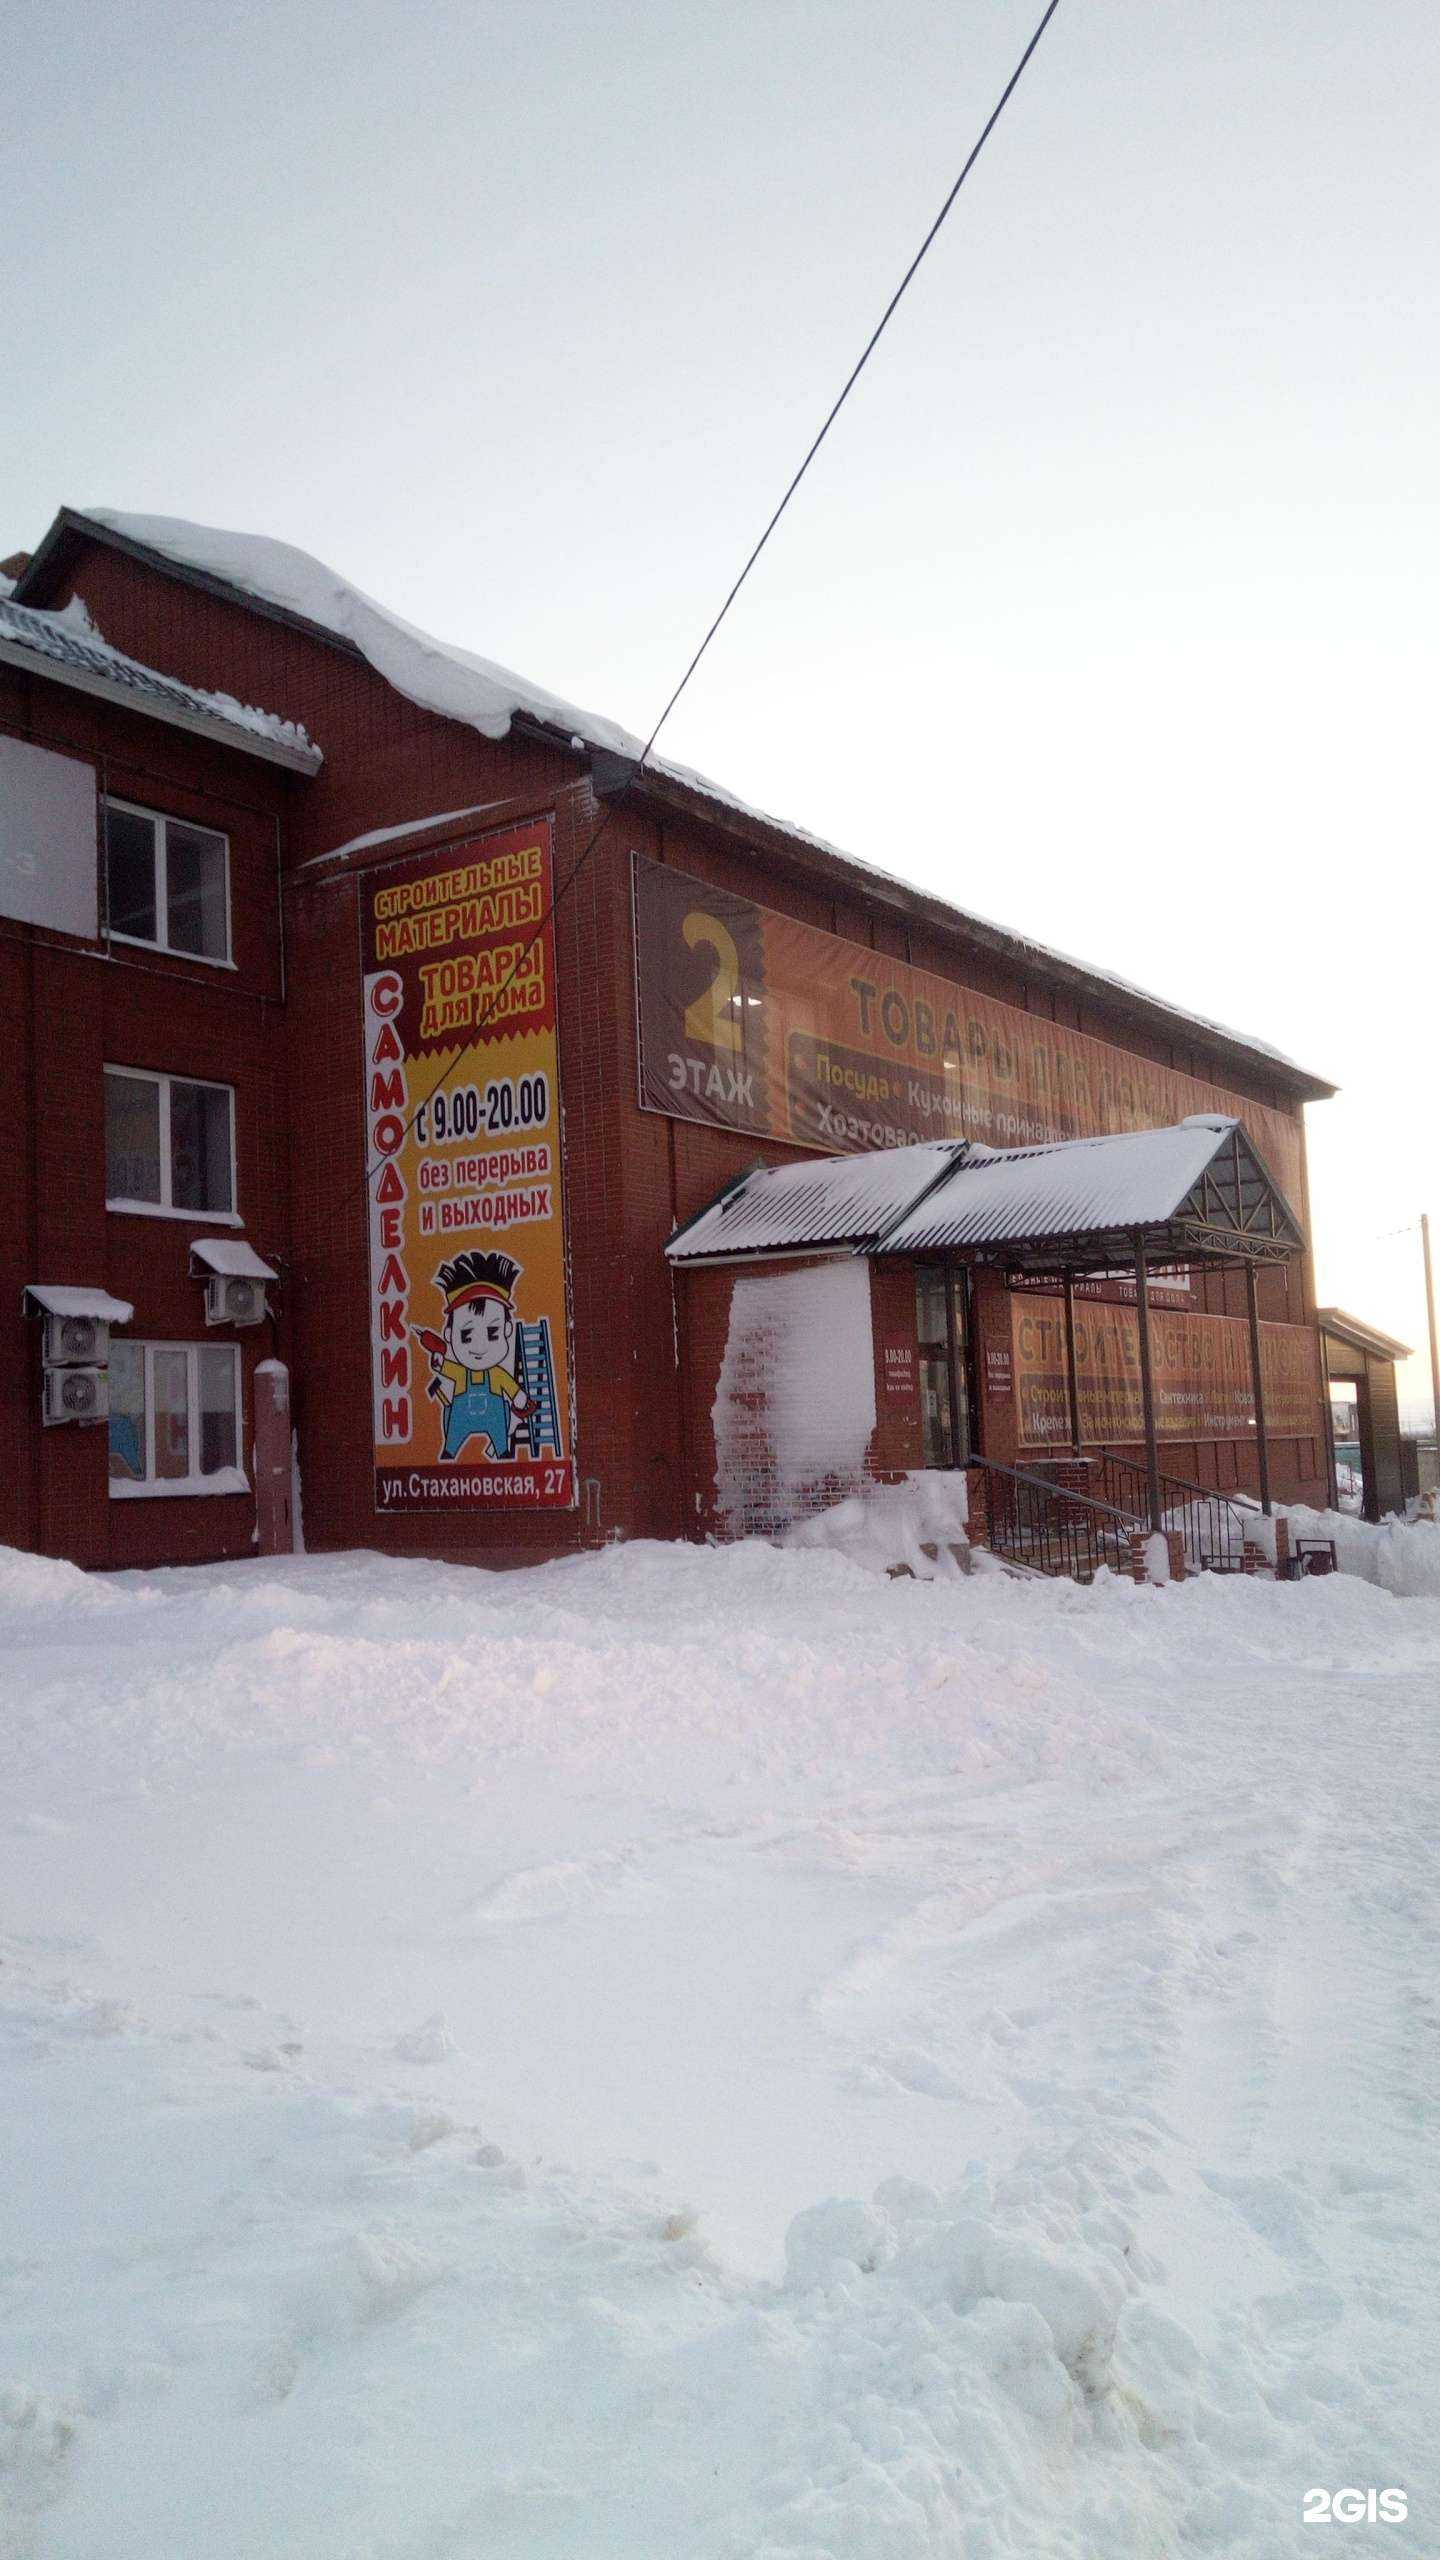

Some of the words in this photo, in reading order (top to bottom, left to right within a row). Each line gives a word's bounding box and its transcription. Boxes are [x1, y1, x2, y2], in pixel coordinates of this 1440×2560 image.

[375, 848, 541, 919] СТРОИТЕЛЬНЫЕ
[376, 883, 541, 960] МАТЕРИАЛЫ
[419, 938, 543, 1001] ТОВАРЫ
[683, 912, 742, 1050] 2
[433, 1077, 546, 1140] 9.00-20.00
[667, 1053, 754, 1108] ЭТАЖ
[816, 1054, 889, 1102] Посуда
[908, 1080, 993, 1127] Кухонные
[420, 1161, 449, 1189] без
[456, 1147, 548, 1184] перерыва
[371, 976, 409, 1438] САМОДЕЛКИН
[544, 1468, 566, 1495] 27
